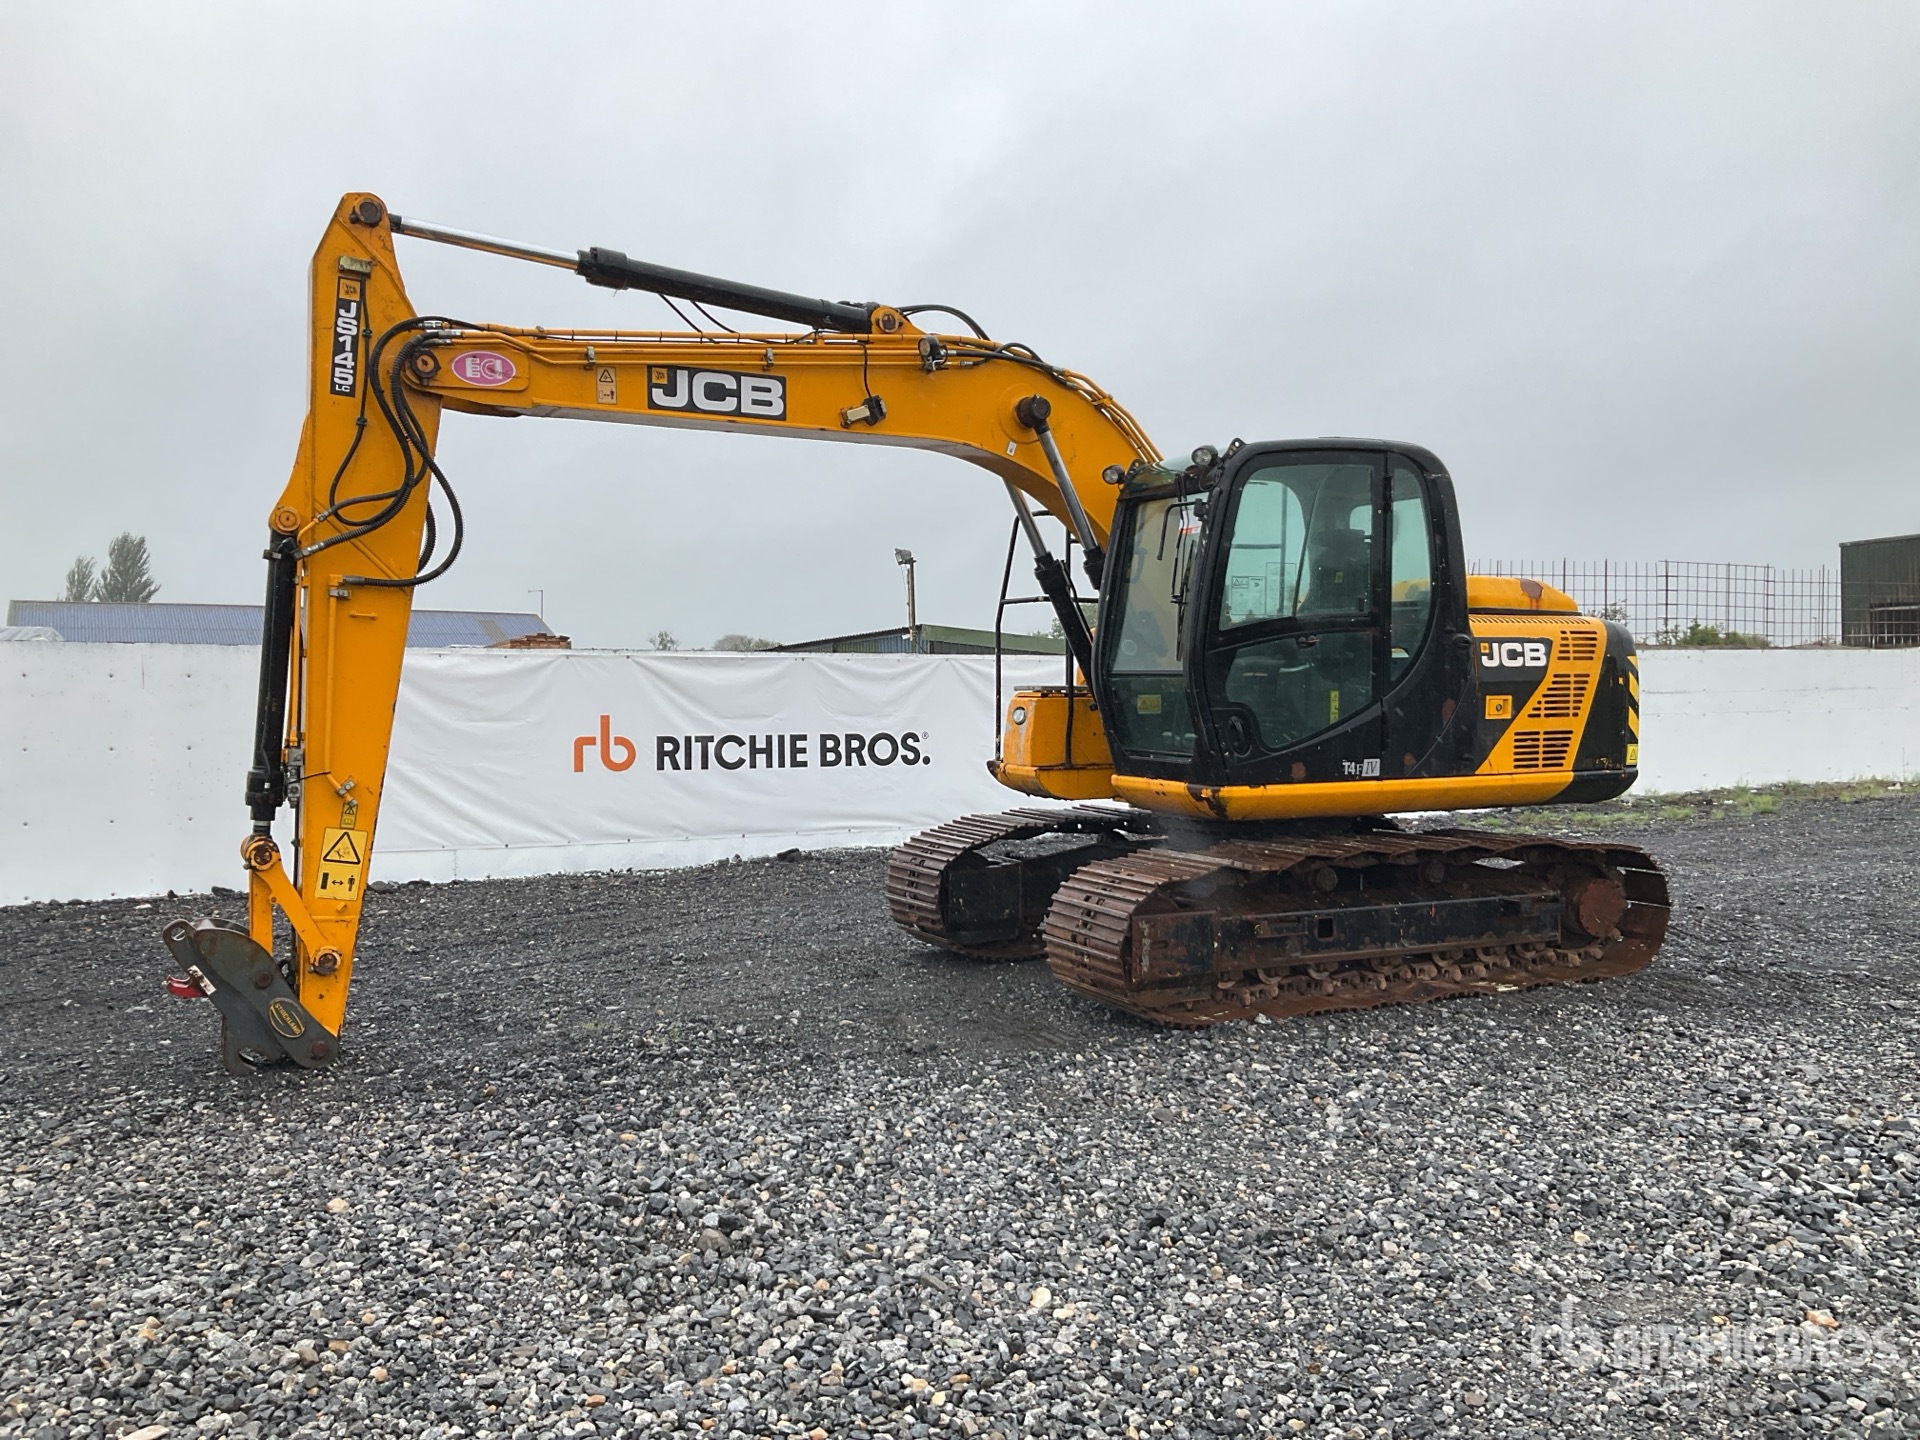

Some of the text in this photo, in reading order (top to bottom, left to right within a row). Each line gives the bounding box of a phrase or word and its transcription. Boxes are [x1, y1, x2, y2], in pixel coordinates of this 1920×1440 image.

[334, 301, 358, 392] JS145 LC
[652, 369, 784, 416] JCB
[1481, 642, 1547, 667] JCB
[573, 714, 637, 773] rb
[656, 734, 808, 771] RITCHIE
[273, 1003, 301, 1035] STRICKLAND
